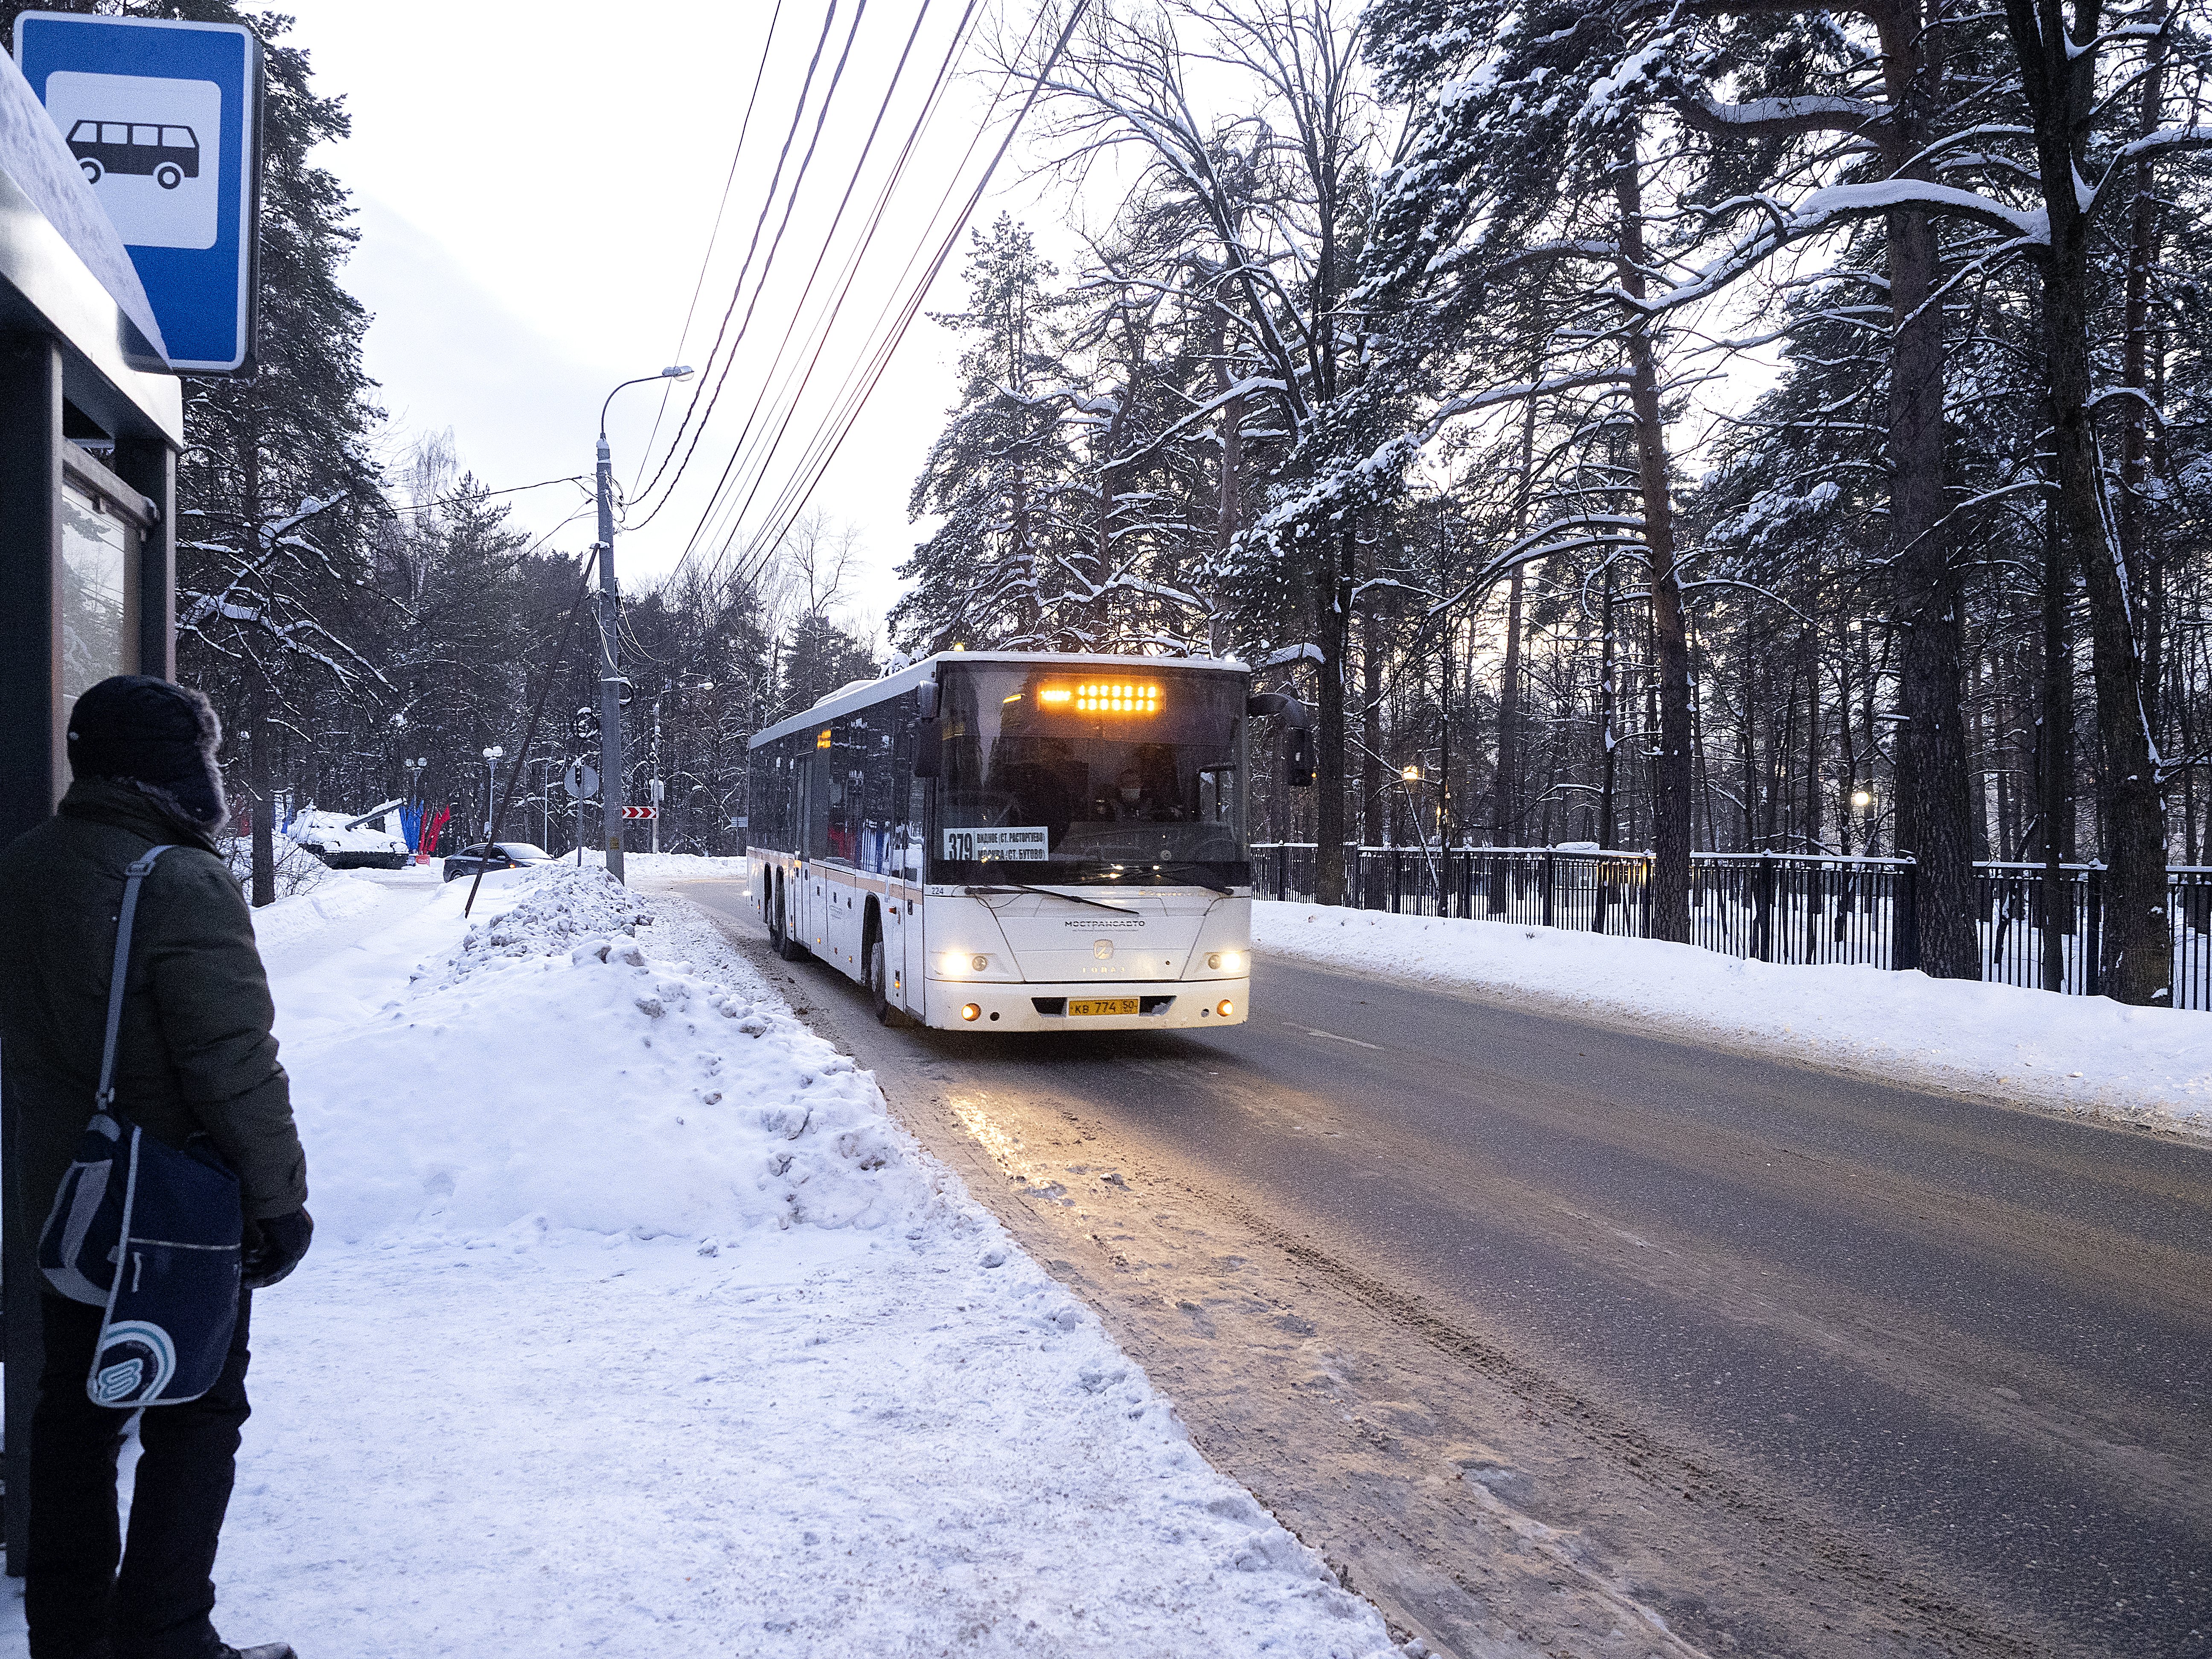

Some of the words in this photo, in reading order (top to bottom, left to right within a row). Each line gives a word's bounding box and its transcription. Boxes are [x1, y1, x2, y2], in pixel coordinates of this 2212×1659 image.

[949, 833, 973, 860] 379
[1095, 1002, 1116, 1013] 774
[1123, 1000, 1135, 1009] 50
